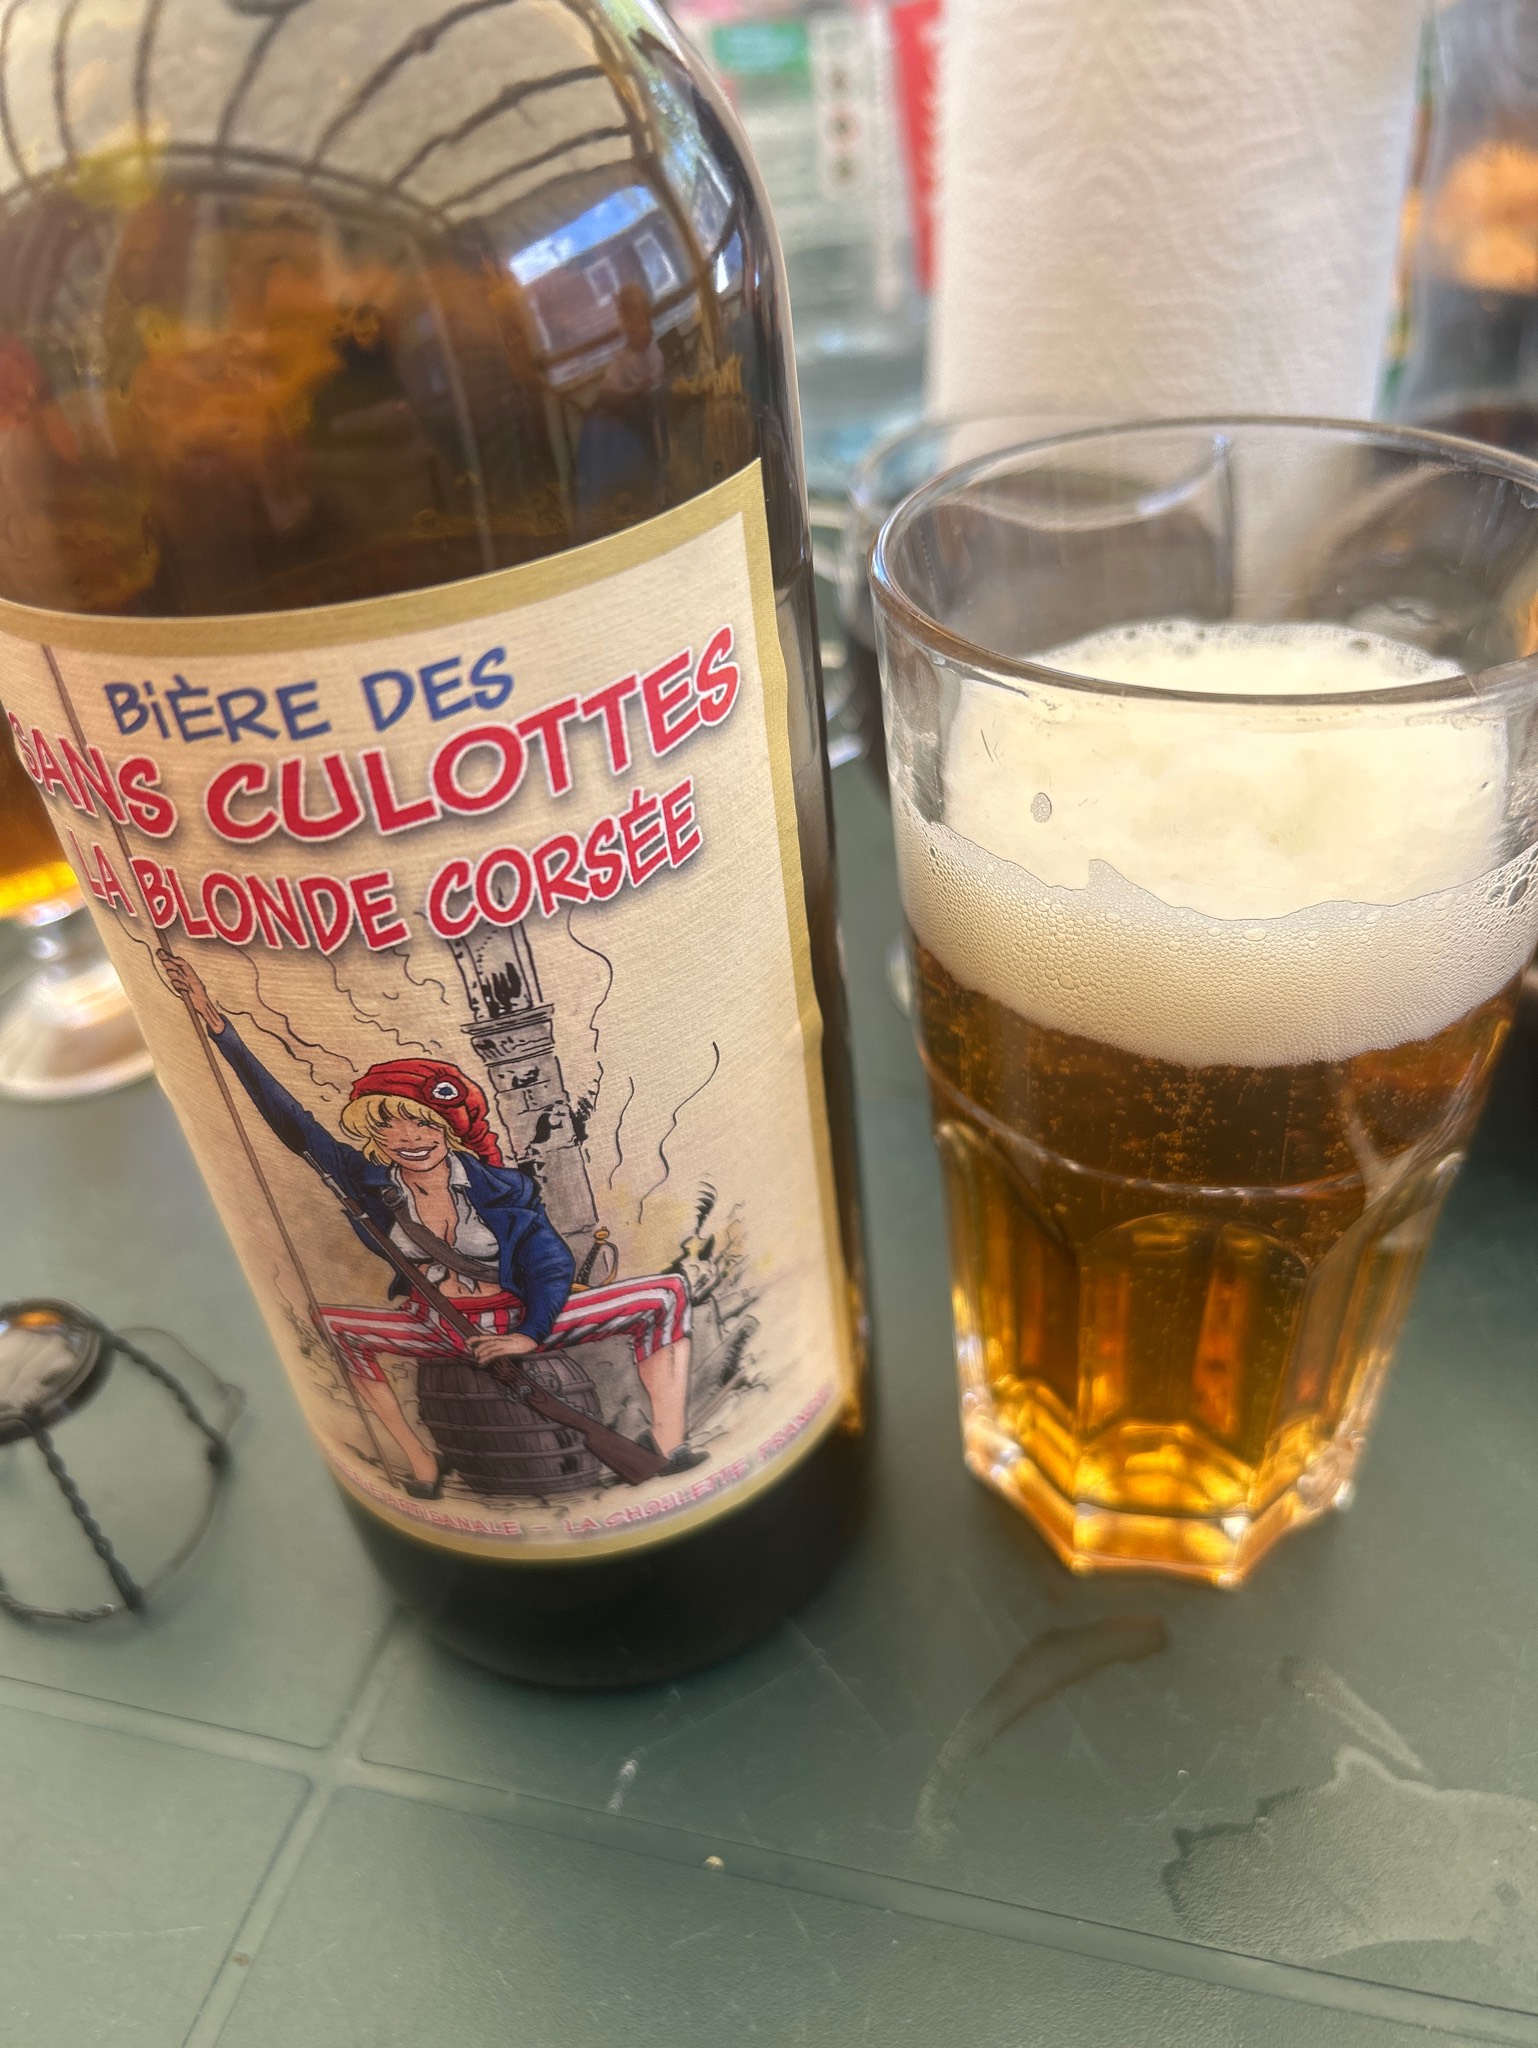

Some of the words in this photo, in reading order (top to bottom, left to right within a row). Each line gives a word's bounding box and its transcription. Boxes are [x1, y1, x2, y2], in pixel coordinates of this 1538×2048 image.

[6, 709, 178, 838] SANS
[205, 623, 741, 844] CULOTTES
[362, 646, 516, 732] DES
[67, 826, 137, 917] LA
[130, 856, 408, 954] BLONDE
[425, 779, 704, 940] CORSÉE
[385, 1495, 523, 1536] ARTISANALE
[564, 1515, 601, 1534] LA
